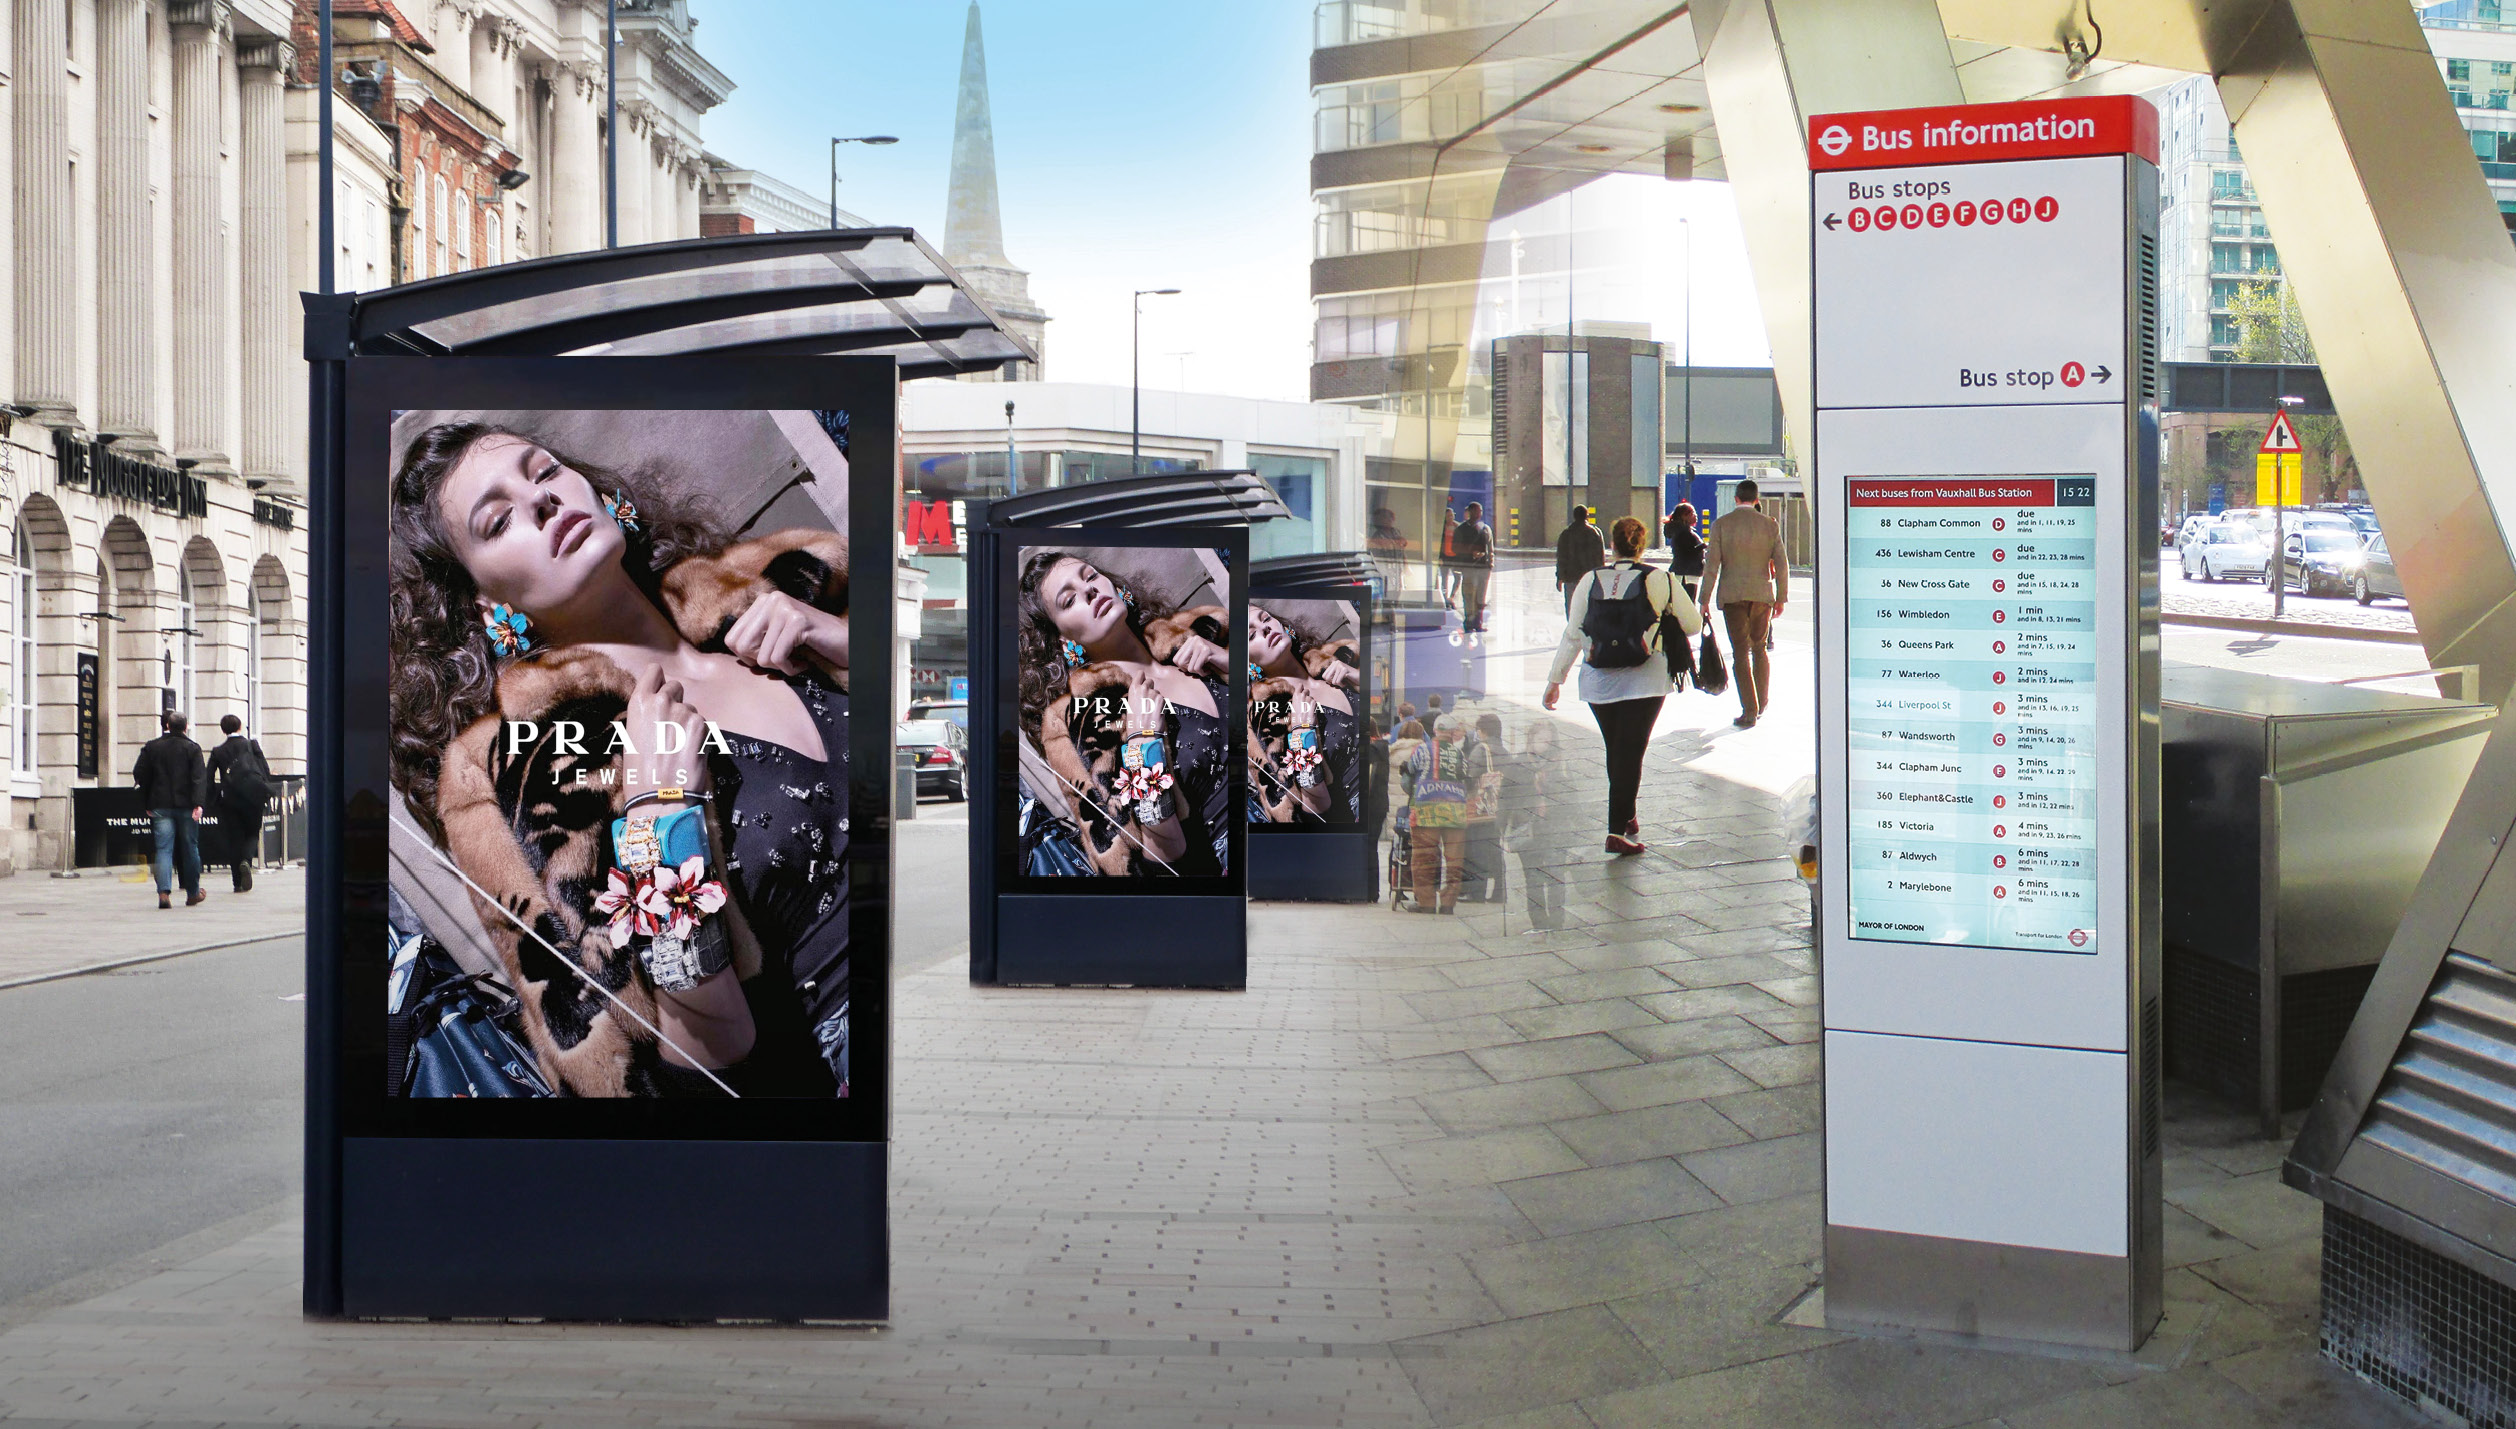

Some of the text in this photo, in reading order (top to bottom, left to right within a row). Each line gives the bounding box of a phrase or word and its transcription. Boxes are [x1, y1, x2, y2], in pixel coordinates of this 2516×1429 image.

[1863, 114, 2095, 151] Bus information
[1848, 180, 1951, 200] Bus stops
[1960, 369, 1998, 387] Bus
[2006, 366, 2054, 390] stop
[52, 429, 91, 486] THE
[1856, 488, 2032, 498] Next buses from Vauxhall Bus Station
[2063, 488, 2090, 497] 15 22
[1880, 519, 1891, 527] 88
[1898, 519, 1937, 528] Clapham
[1940, 519, 1980, 527] Common
[2017, 544, 2035, 552] due
[1876, 549, 1891, 557] 436
[1898, 549, 1942, 557] Lewisham
[1944, 550, 1975, 558] Centre
[2017, 572, 2035, 580] due
[1881, 580, 1891, 588] 36
[1898, 580, 1918, 588] New
[1921, 580, 1946, 588] Cross
[1948, 580, 1970, 588] Gate
[1877, 610, 1892, 618] 156
[1898, 610, 1950, 618] Wimbledon
[2019, 606, 2043, 614] 1 min
[2018, 633, 2048, 641] 2 mins
[1881, 640, 1892, 648] 36
[1898, 640, 1932, 649] Queens
[1935, 641, 1954, 649] Park
[1882, 670, 1892, 678] 77
[1899, 670, 1940, 679] Waterloo
[2018, 667, 2048, 676] 2 mins
[2018, 694, 2048, 703] 3 mins
[1074, 697, 1176, 714] PRADA
[1255, 701, 1325, 714] PRADA
[1876, 700, 1892, 708] 344
[1899, 701, 1940, 710] Liverpool
[1942, 701, 1951, 709] St
[1094, 720, 1157, 728] JEWELS
[2018, 726, 2048, 735] 3 mins
[506, 721, 734, 755] PRADA
[1882, 731, 1892, 739] 87
[1899, 731, 1955, 741] Wandsworth
[2018, 758, 2048, 766] 3 mins
[1877, 762, 1892, 770] 344
[1899, 763, 1938, 772] Clapham
[1941, 764, 1961, 772] Junc
[552, 768, 688, 785] JEWELS
[1877, 792, 1892, 800] 360
[1899, 793, 1973, 803] Elephant&Castle
[2018, 792, 2048, 801] 3 mins
[106, 818, 128, 826] THE
[198, 816, 218, 824] INN
[1900, 821, 1934, 831] Victoria
[2026, 822, 2048, 830] mins
[1900, 852, 1937, 862] Aldwych
[2018, 848, 2048, 858] 6 mins
[1888, 881, 1893, 889] 2
[1900, 882, 1951, 892] Marylebone
[2018, 879, 2048, 888] 6 mins
[1894, 923, 1924, 931] LONDON
